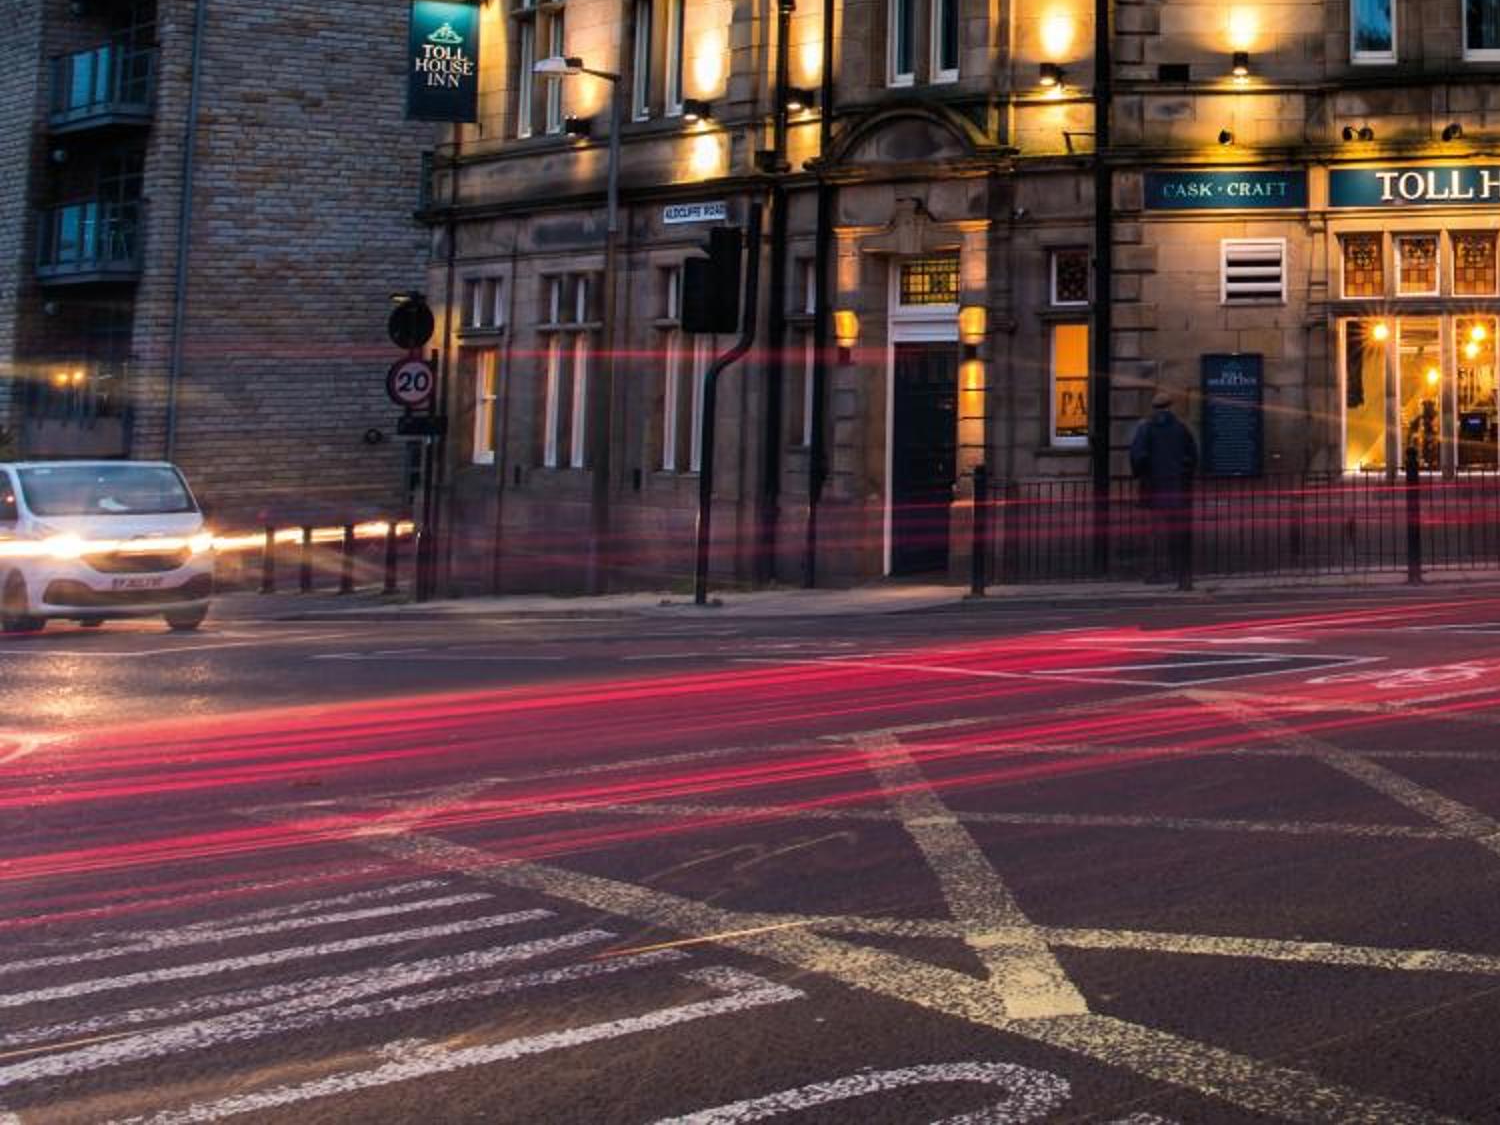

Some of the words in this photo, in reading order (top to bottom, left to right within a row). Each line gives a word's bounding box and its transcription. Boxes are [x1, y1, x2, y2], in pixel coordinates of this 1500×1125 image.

[422, 44, 467, 62] TOLL
[415, 58, 474, 75] HOUSE
[427, 73, 460, 88] INN
[1163, 182, 1213, 196] CASK
[1227, 182, 1287, 196] CRAFT
[1376, 171, 1474, 200] TOLL
[398, 371, 429, 392] 20
